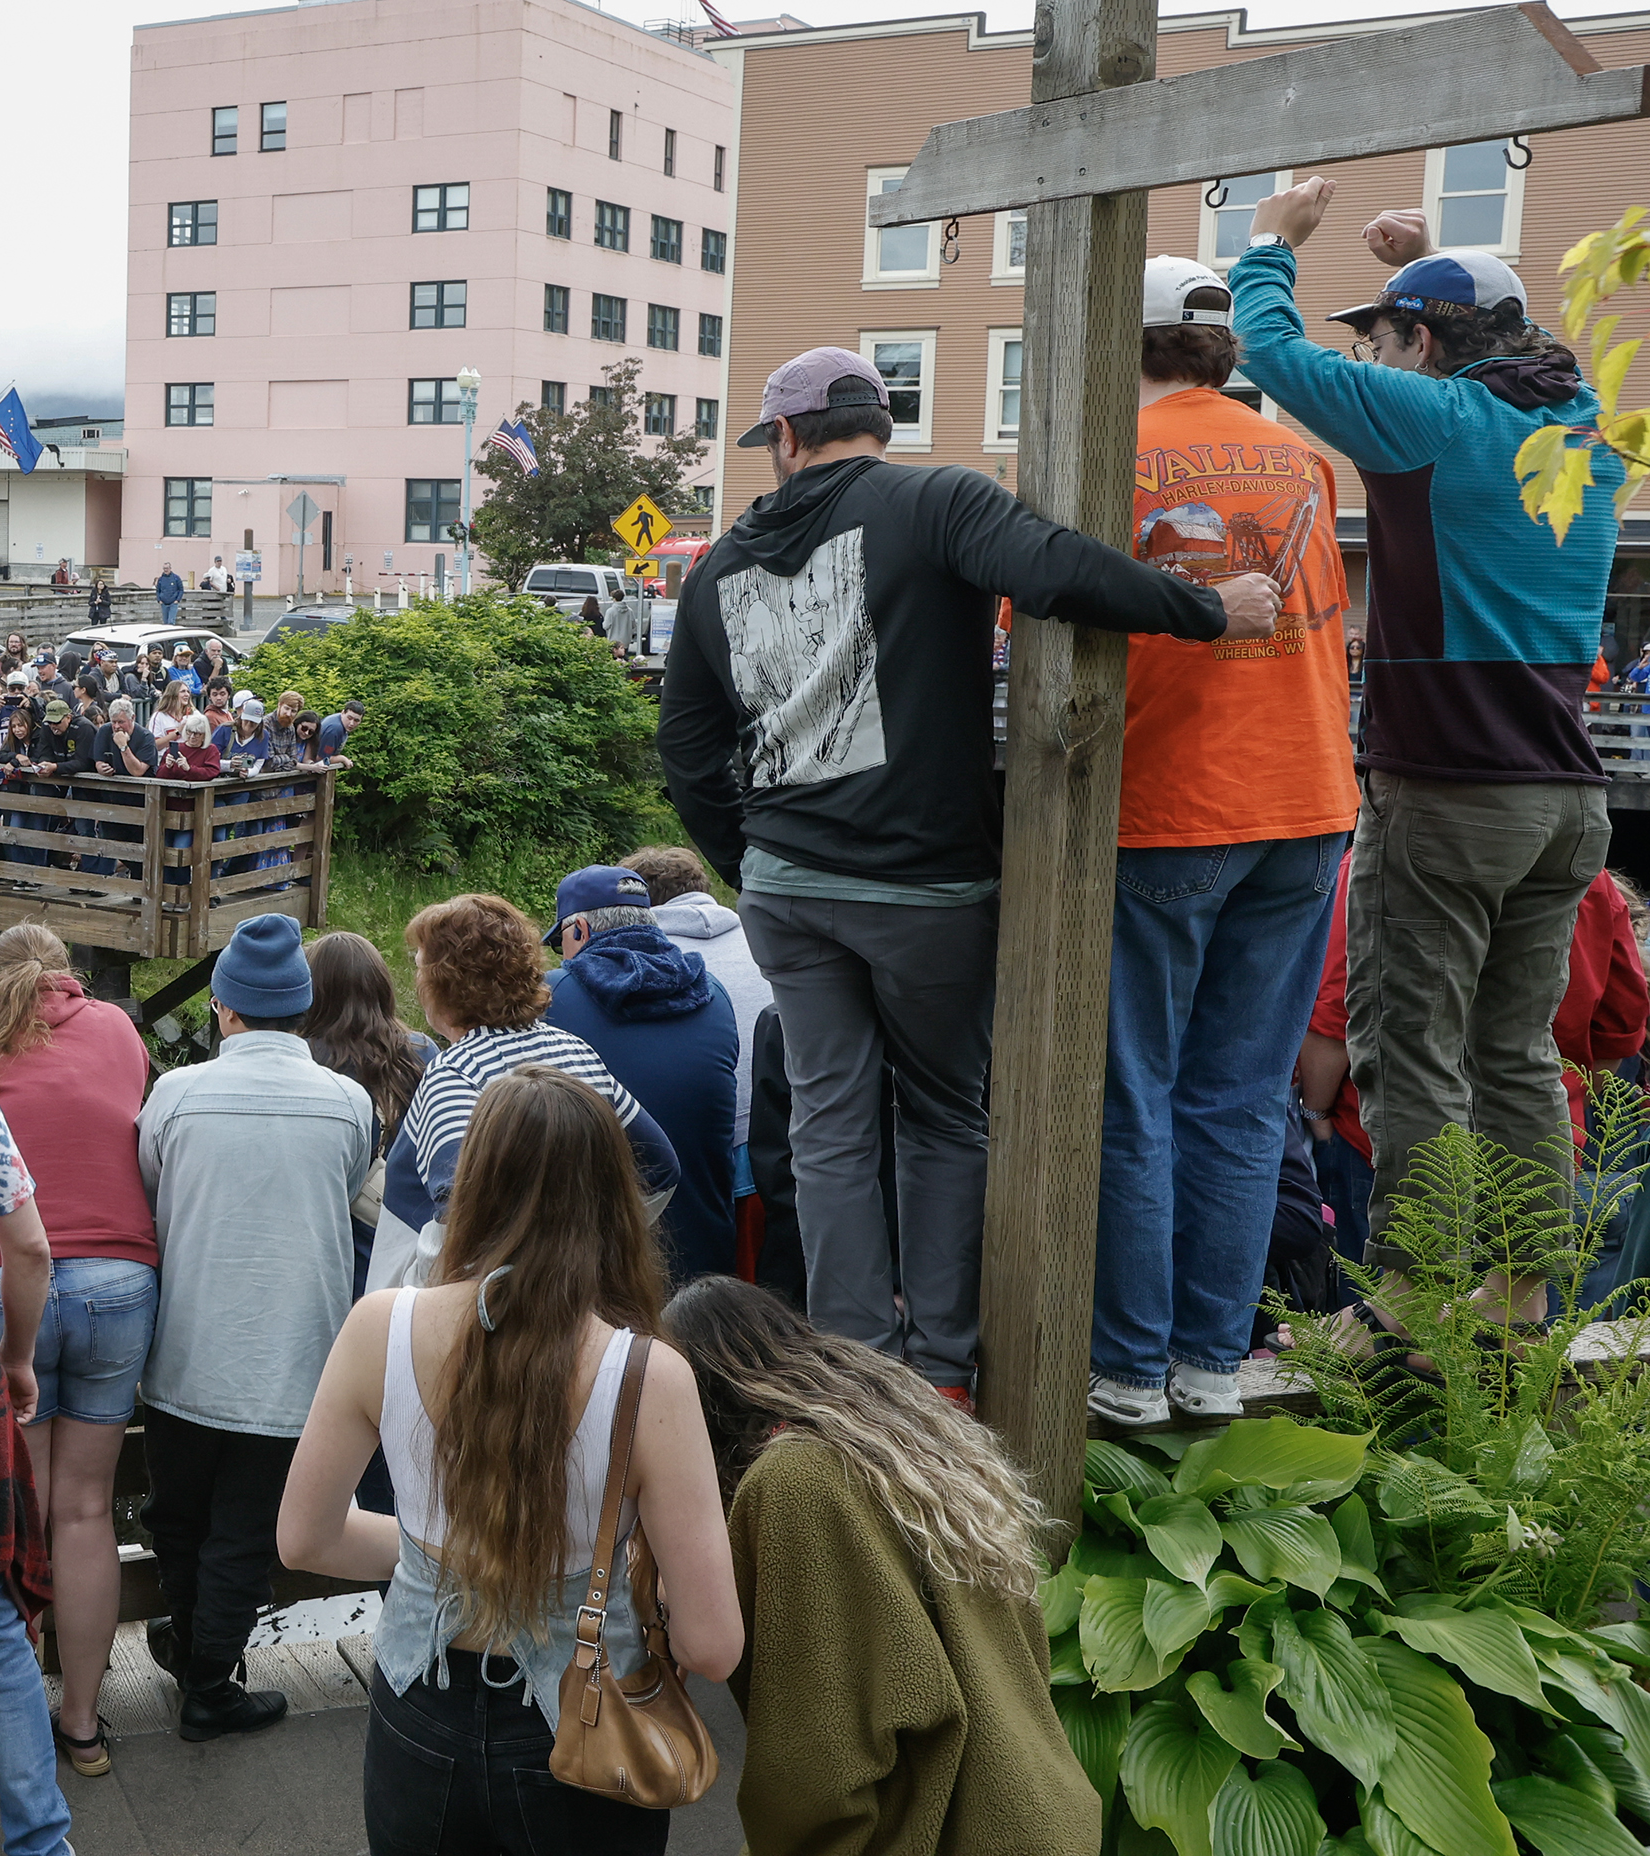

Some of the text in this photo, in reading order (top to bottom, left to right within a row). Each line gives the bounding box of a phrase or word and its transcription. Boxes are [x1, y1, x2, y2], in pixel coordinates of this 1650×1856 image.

[1399, 300, 1420, 308] KAVU
[1136, 443, 1320, 494] VALLEY
[1161, 479, 1306, 506] HARLEY-DAVIDSON
[1273, 628, 1306, 642] OHIO
[1213, 643, 1305, 661] WHEELING, WV
[1116, 1384, 1131, 1392] NIKE
